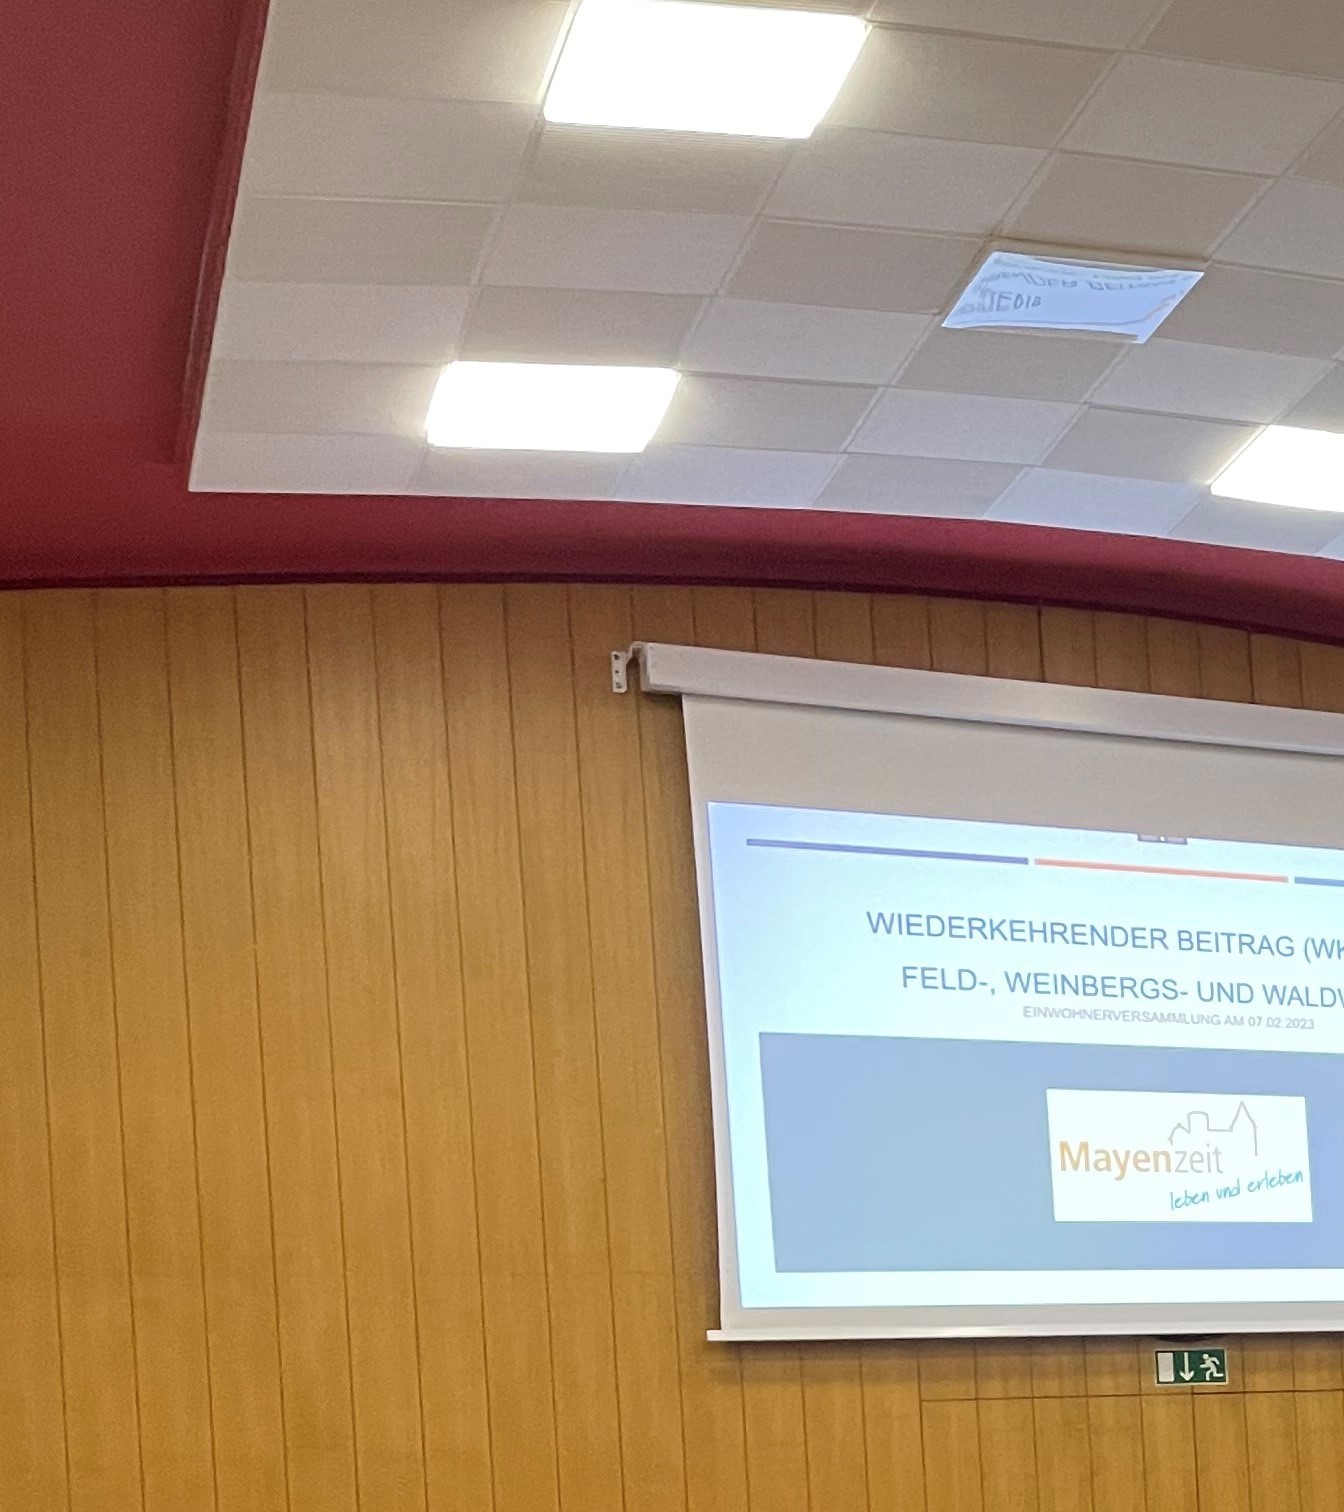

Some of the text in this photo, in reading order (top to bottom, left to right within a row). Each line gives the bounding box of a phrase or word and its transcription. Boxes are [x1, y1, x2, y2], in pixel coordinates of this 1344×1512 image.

[866, 910, 1168, 950] WIEDERKEHRENDER
[1177, 930, 1294, 957] BEITRAG
[902, 966, 996, 996] FELD-,
[1004, 970, 1188, 1000] WEINBERGS-
[1197, 981, 1254, 1004] UND
[1023, 1005, 1221, 1026] EINWOHNERVERSAMMLUNG
[1224, 1015, 1245, 1026] AM
[1059, 1140, 1223, 1181] Mayenzeit
[1170, 1168, 1304, 1211] leben und erleben
